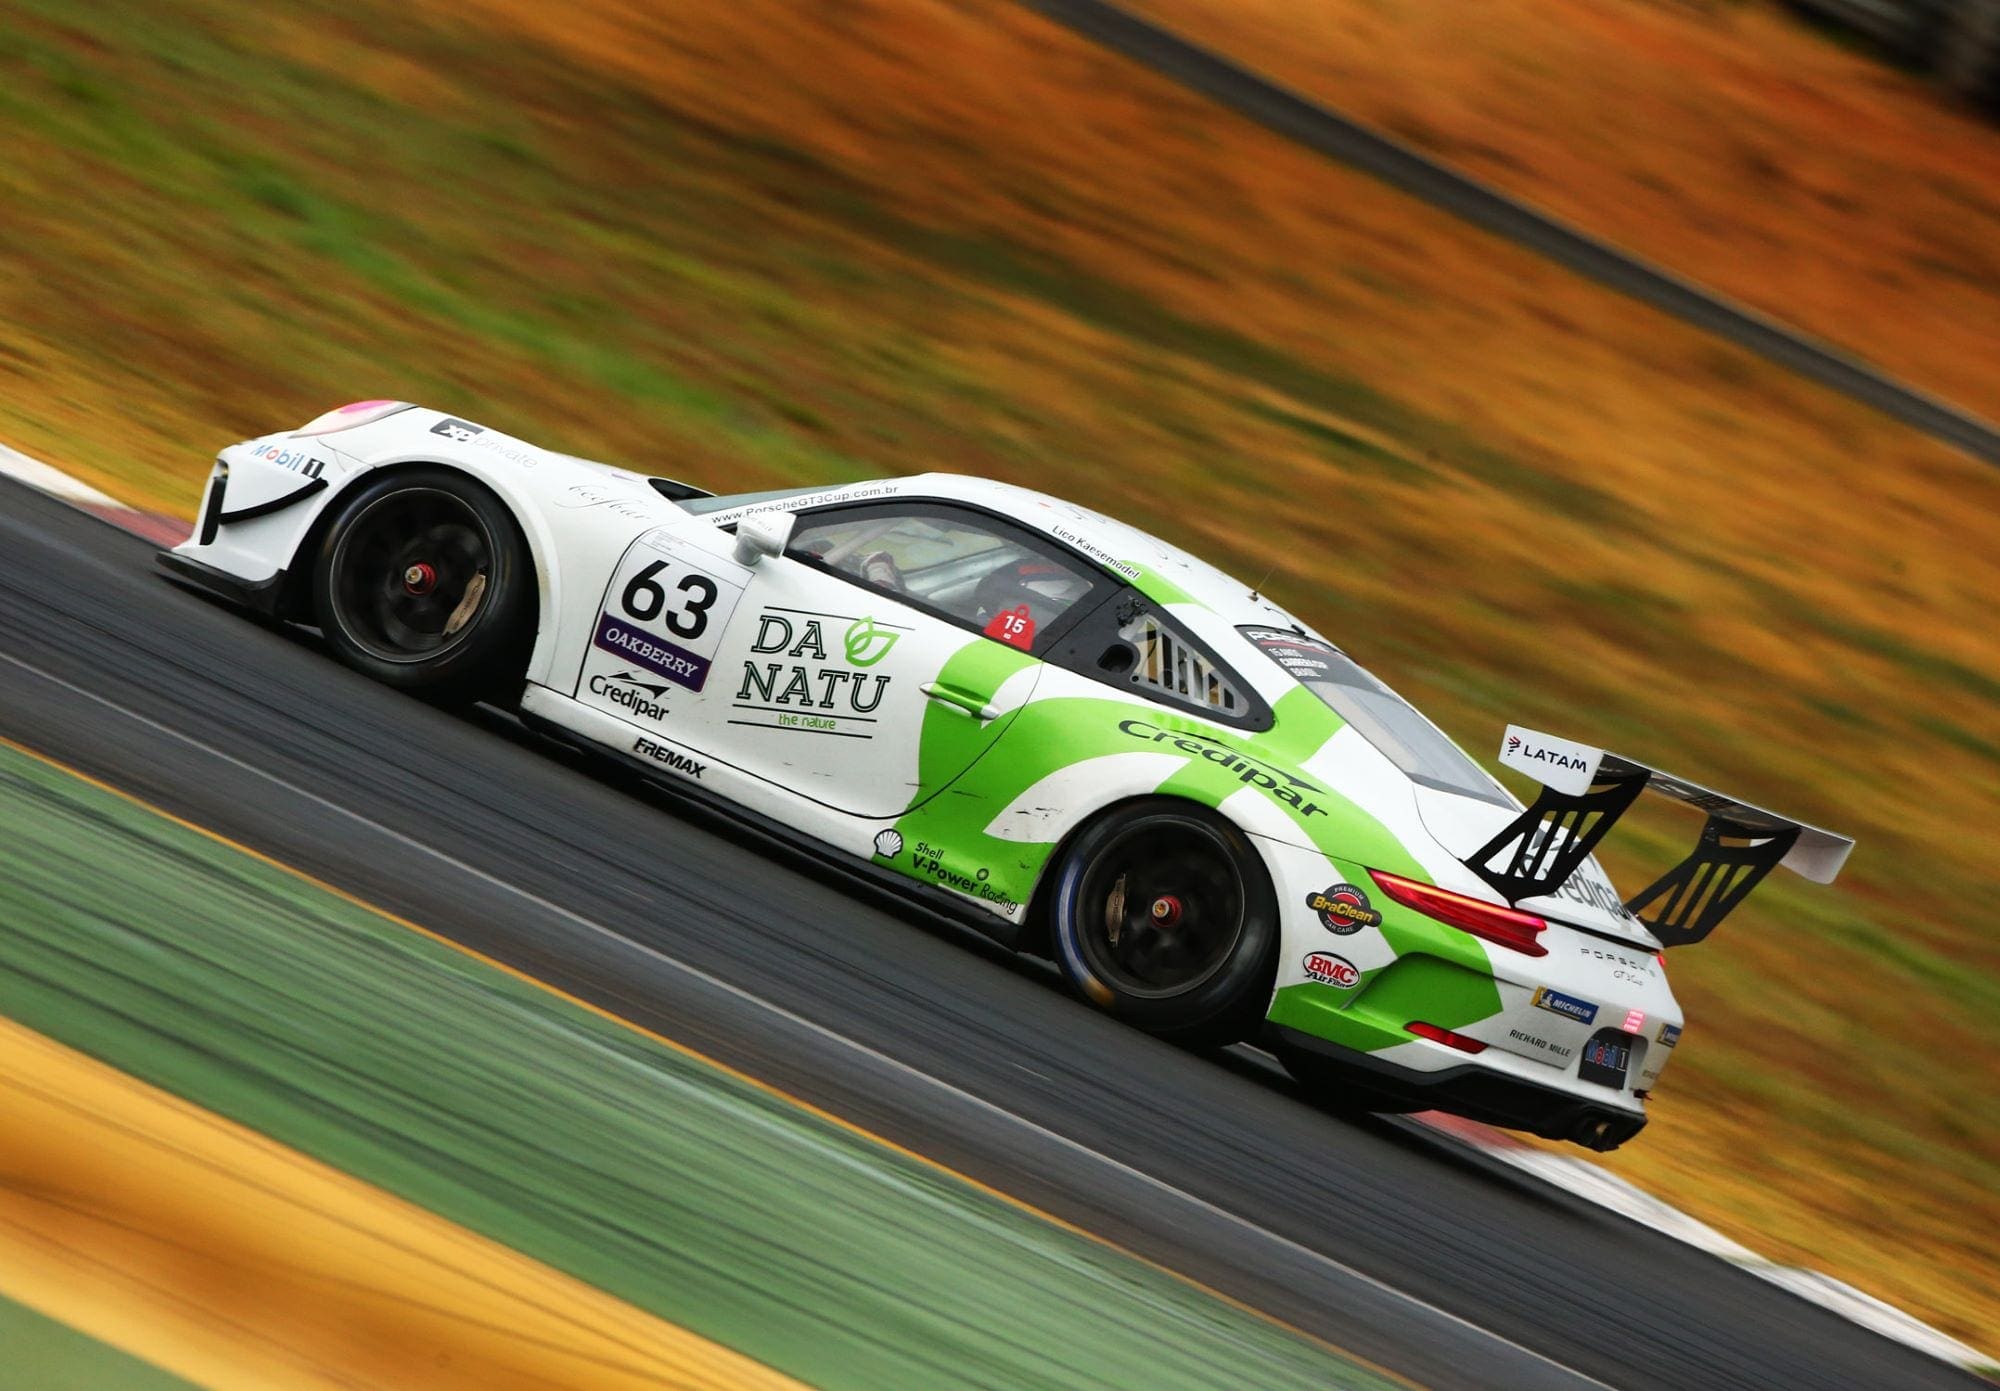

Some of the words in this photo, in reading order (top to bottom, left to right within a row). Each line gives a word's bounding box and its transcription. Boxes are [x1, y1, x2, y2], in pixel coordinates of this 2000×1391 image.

[250, 445, 305, 471] Mobil
[473, 436, 538, 469] private
[711, 486, 899, 523] www.PorscheGT3Cup.com.br
[1052, 525, 1076, 542] Lico
[1076, 537, 1140, 579] Kaesemodel
[621, 559, 718, 640] 63
[750, 615, 827, 660] DA
[1004, 615, 1027, 634] 15
[605, 627, 699, 678] OAKBERRY
[589, 674, 670, 722] Credipar
[736, 661, 891, 713] NATU
[778, 713, 798, 726] the
[801, 716, 836, 730] nature
[633, 736, 707, 778] FREMAX
[1119, 720, 1329, 817] Credipar
[1523, 744, 1588, 773] LATAM
[915, 842, 944, 860] Shell
[912, 853, 978, 892] V-Power
[980, 883, 1018, 914] Racing
[1334, 886, 1365, 900] PREMIUM
[1312, 896, 1373, 922] BraClean
[1324, 920, 1337, 931] CAR
[1304, 971, 1328, 983] Air
[1308, 956, 1356, 984] BMC
[1553, 999, 1592, 1018] MICHELIN
[1509, 1029, 1548, 1049] RICHARD
[1549, 1044, 1571, 1057] MILLE
